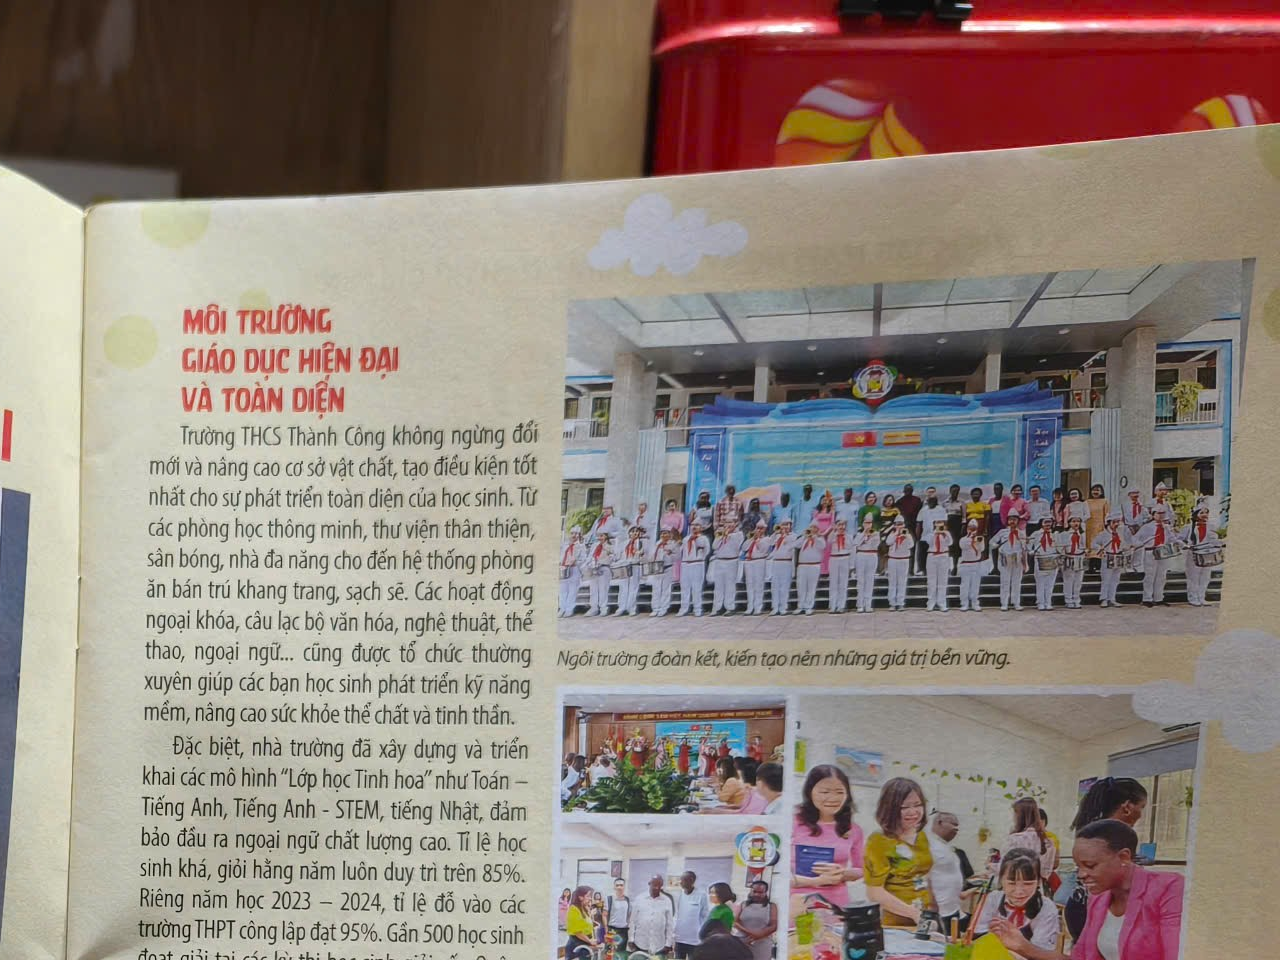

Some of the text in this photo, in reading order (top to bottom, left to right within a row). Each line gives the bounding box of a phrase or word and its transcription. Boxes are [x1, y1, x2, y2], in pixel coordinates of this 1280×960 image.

[182, 304, 331, 335] MÔI TRƯỜNG
[182, 342, 399, 381] GIÁO DỤC HIỆN ĐẠI
[181, 380, 345, 419] VÀ TOÀN DIỆN
[180, 420, 538, 451] Trường THCS Thành Công không ngừng đổi
[557, 650, 594, 671] Ngôi
[597, 650, 648, 671] trường
[651, 650, 692, 666] đoàn
[694, 648, 721, 668] kết,
[724, 648, 757, 666] kiến
[761, 652, 788, 670] tạo
[790, 650, 821, 666] nên
[823, 649, 878, 670] những
[880, 649, 907, 670] giá
[910, 649, 928, 669] trị
[965, 649, 1010, 670] vững.
